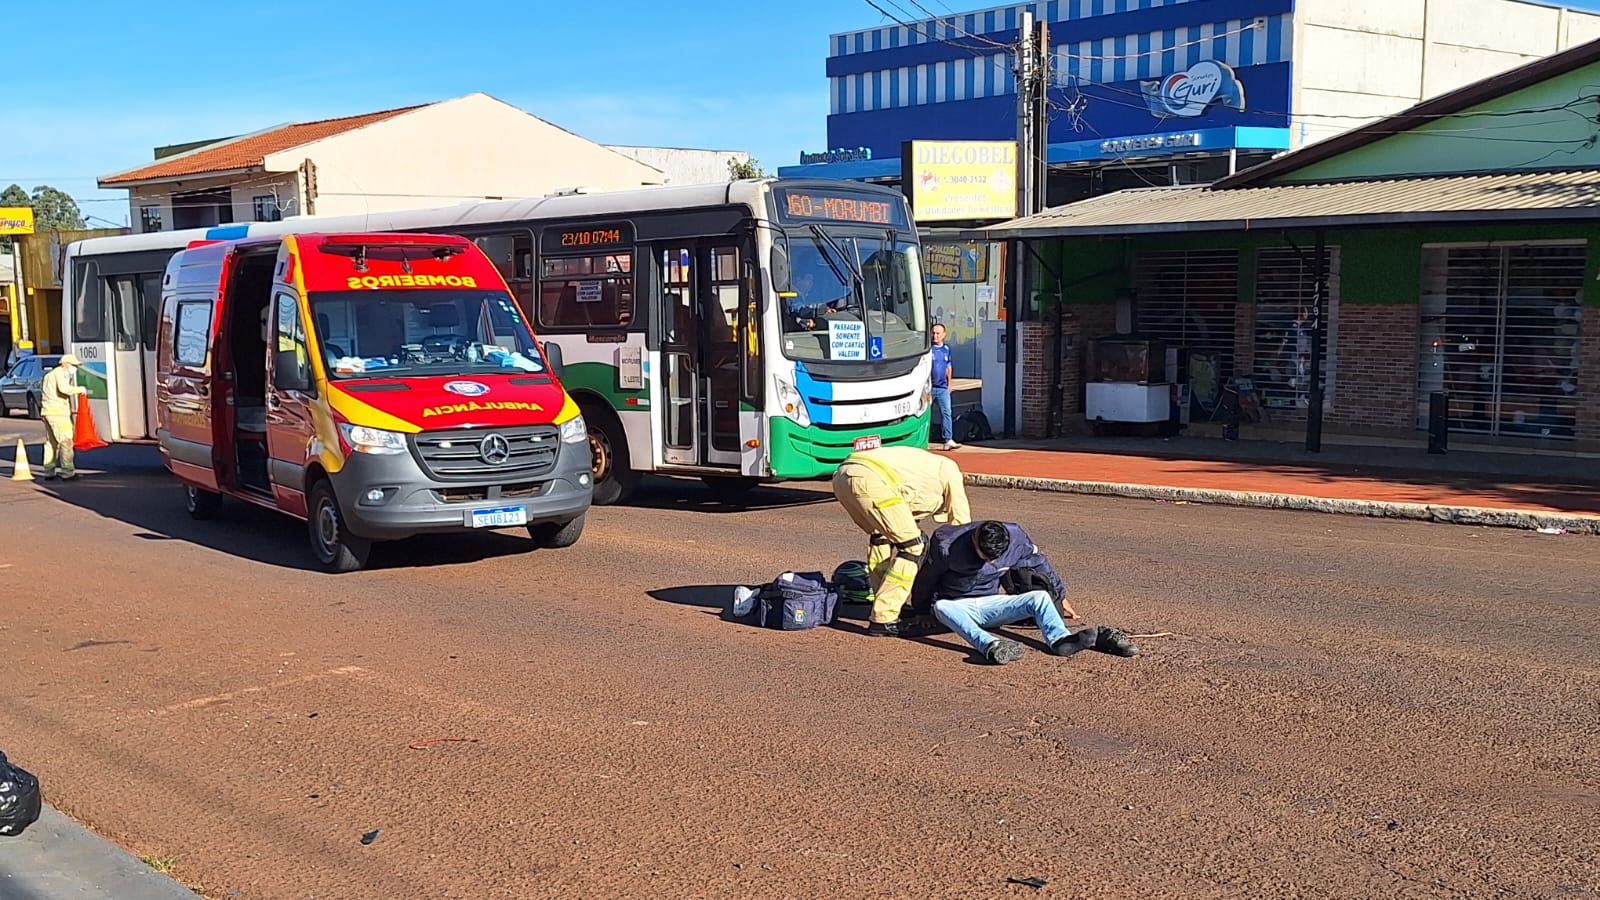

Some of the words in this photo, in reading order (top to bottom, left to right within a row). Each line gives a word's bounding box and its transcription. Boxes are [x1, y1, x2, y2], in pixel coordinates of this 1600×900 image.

[1173, 78, 1217, 105] Guri
[1164, 133, 1199, 148] GURI
[917, 145, 1014, 165] DIEGOBEL
[561, 232, 591, 246] 23/10
[592, 229, 620, 244] 07:44
[834, 323, 862, 331] PASSAGEM
[836, 332, 860, 340] SOMENTE
[831, 341, 844, 349] COM
[79, 346, 98, 359] 1060
[838, 350, 860, 358] VALESIM
[894, 401, 911, 415] 1060
